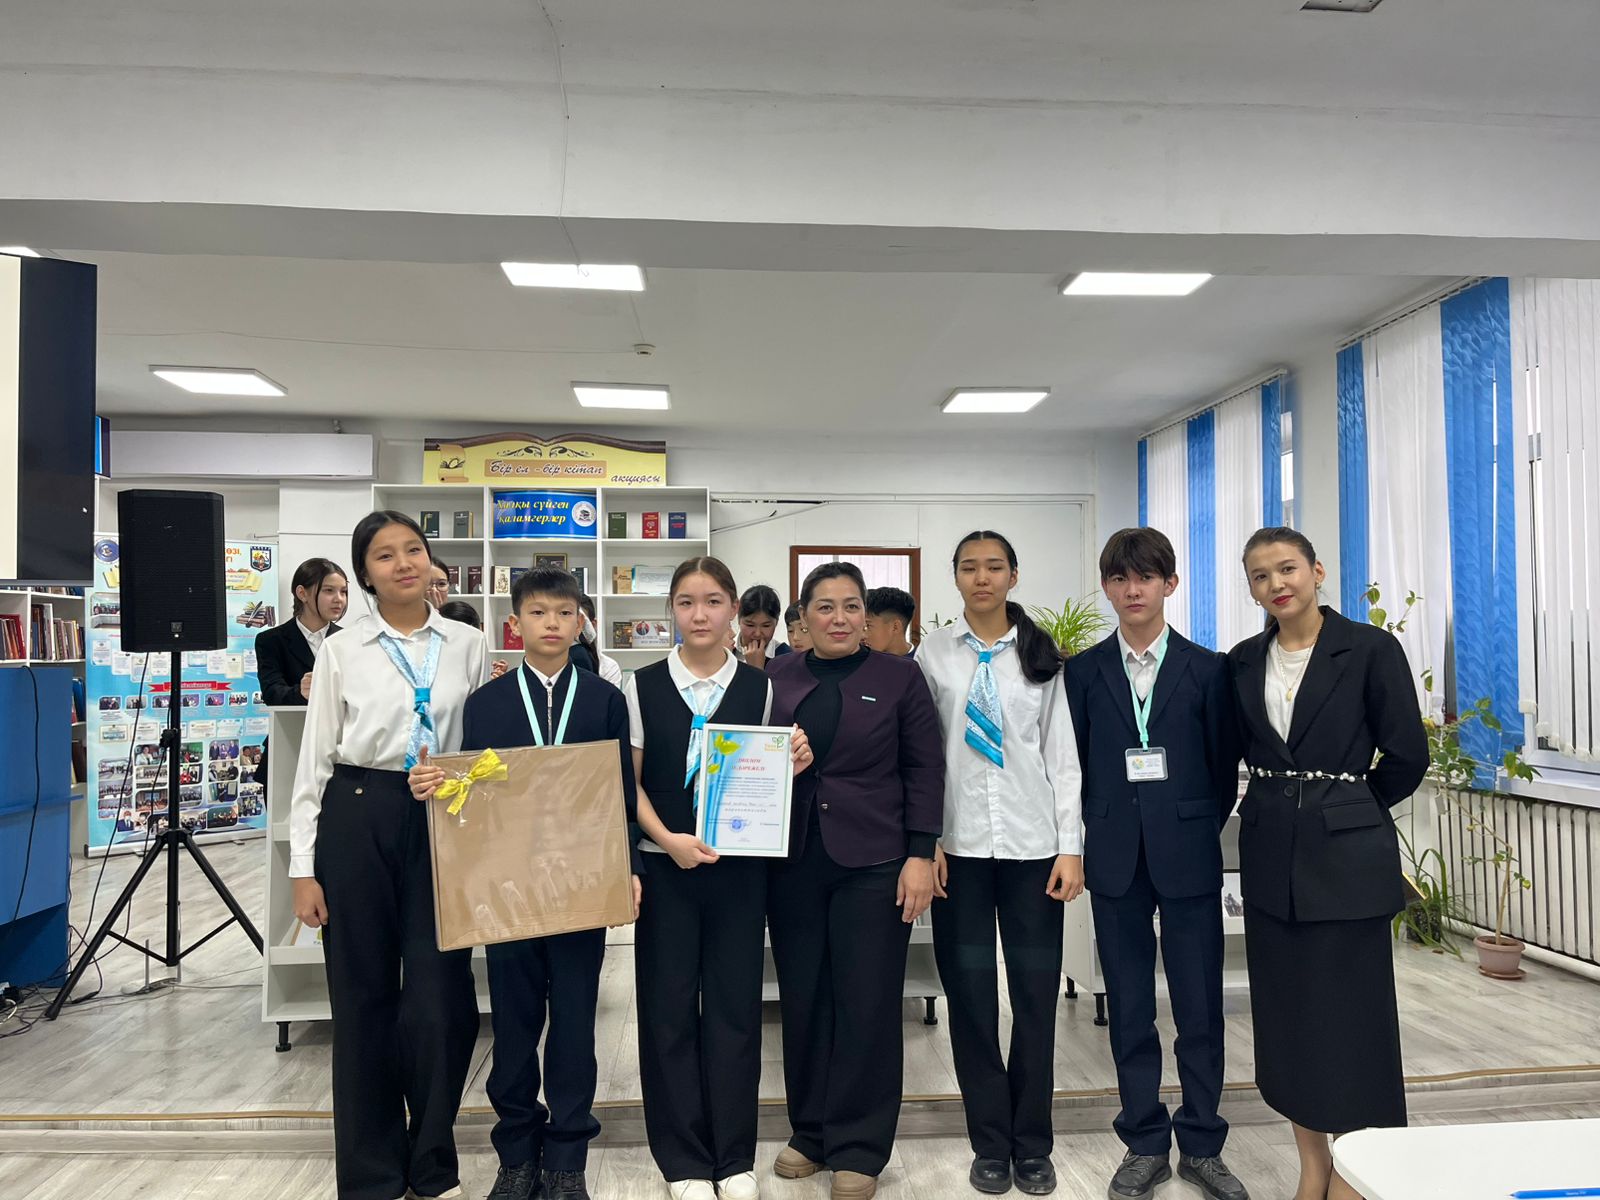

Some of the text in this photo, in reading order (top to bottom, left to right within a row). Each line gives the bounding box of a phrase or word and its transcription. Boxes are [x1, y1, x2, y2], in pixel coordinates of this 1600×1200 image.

[490, 460, 512, 476] Бір
[564, 464, 603, 474] кітап
[610, 475, 661, 486] акциясы
[533, 499, 569, 511] сүйген
